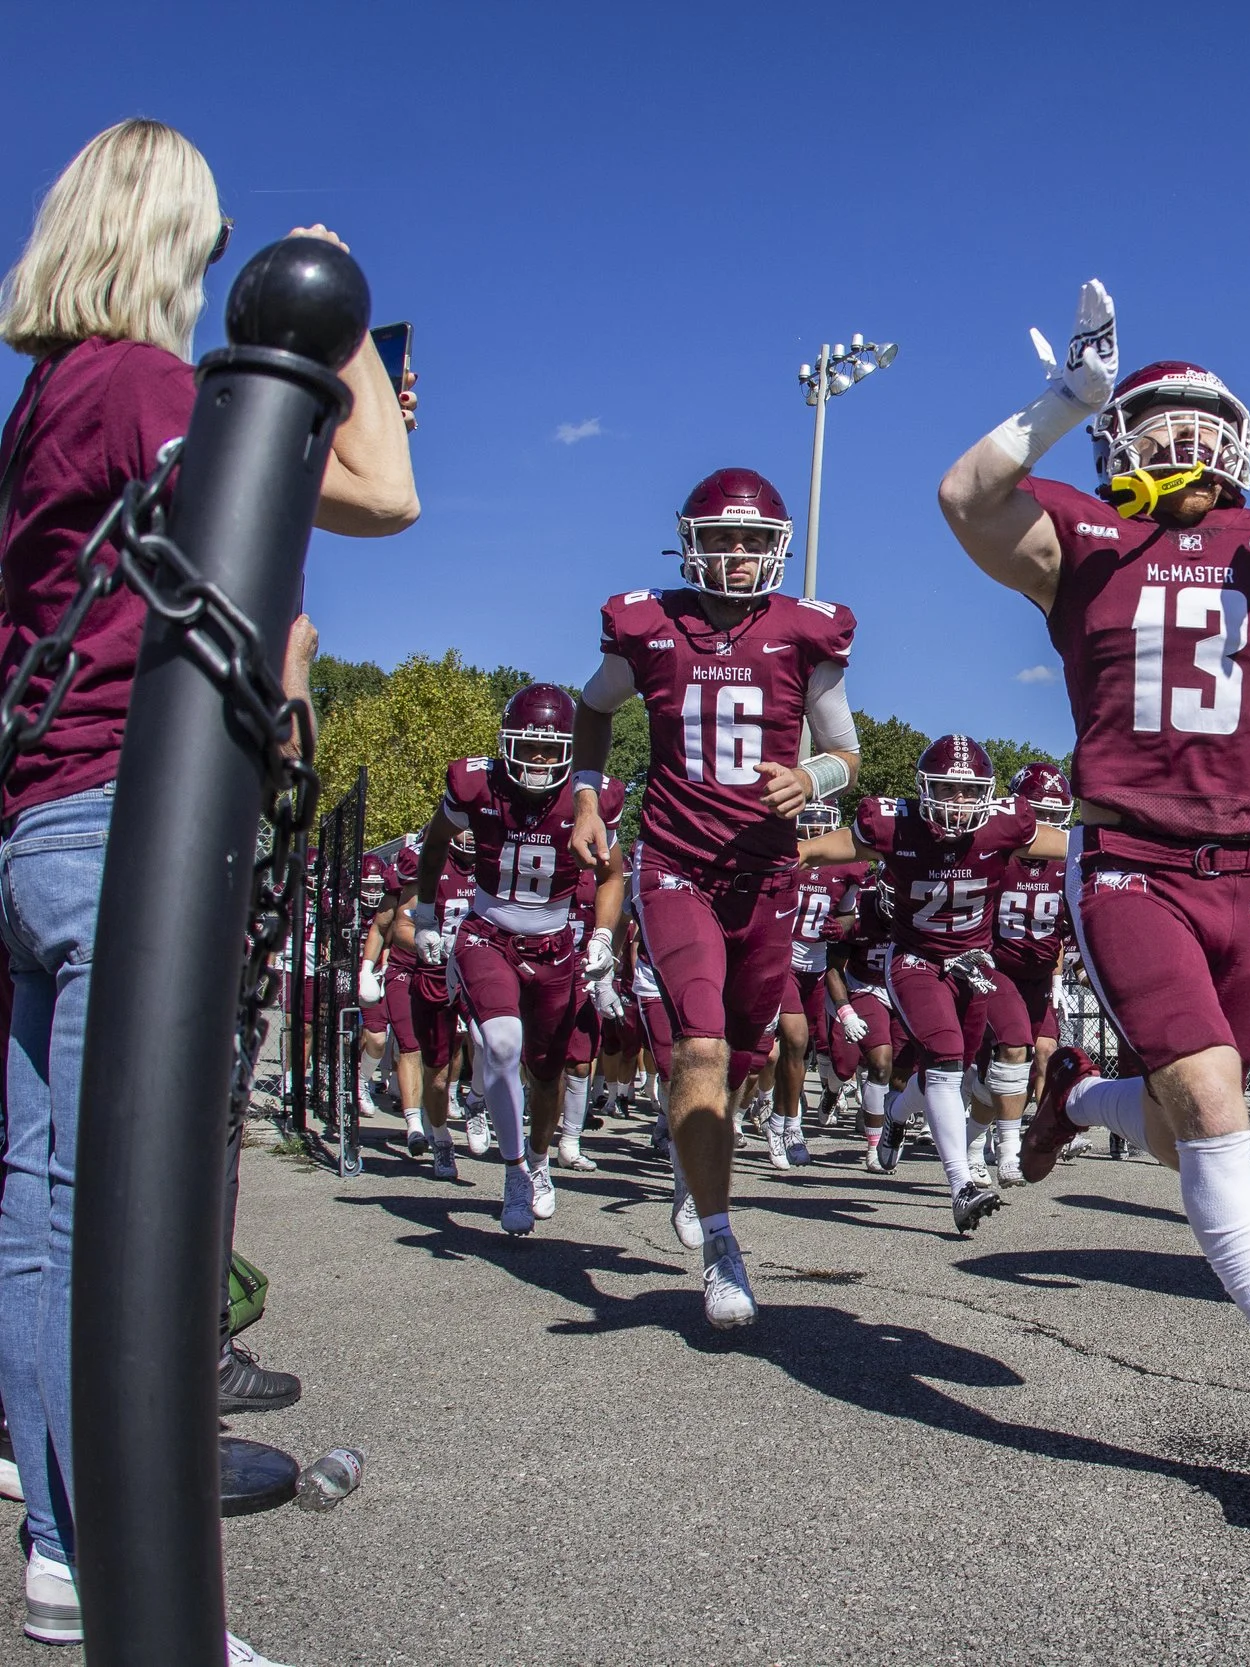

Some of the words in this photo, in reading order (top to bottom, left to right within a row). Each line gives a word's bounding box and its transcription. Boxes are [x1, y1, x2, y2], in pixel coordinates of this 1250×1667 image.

[1076, 522, 1120, 540] OUA
[1147, 563, 1234, 584] McMASTER
[1132, 586, 1248, 735] 13
[692, 665, 752, 681] McMASTER
[681, 684, 764, 786] 16
[507, 830, 551, 844] McMASTER
[497, 841, 556, 904] 18
[929, 868, 972, 879] McMASTER
[1016, 881, 1050, 891] McMASTER
[910, 878, 989, 933] 25
